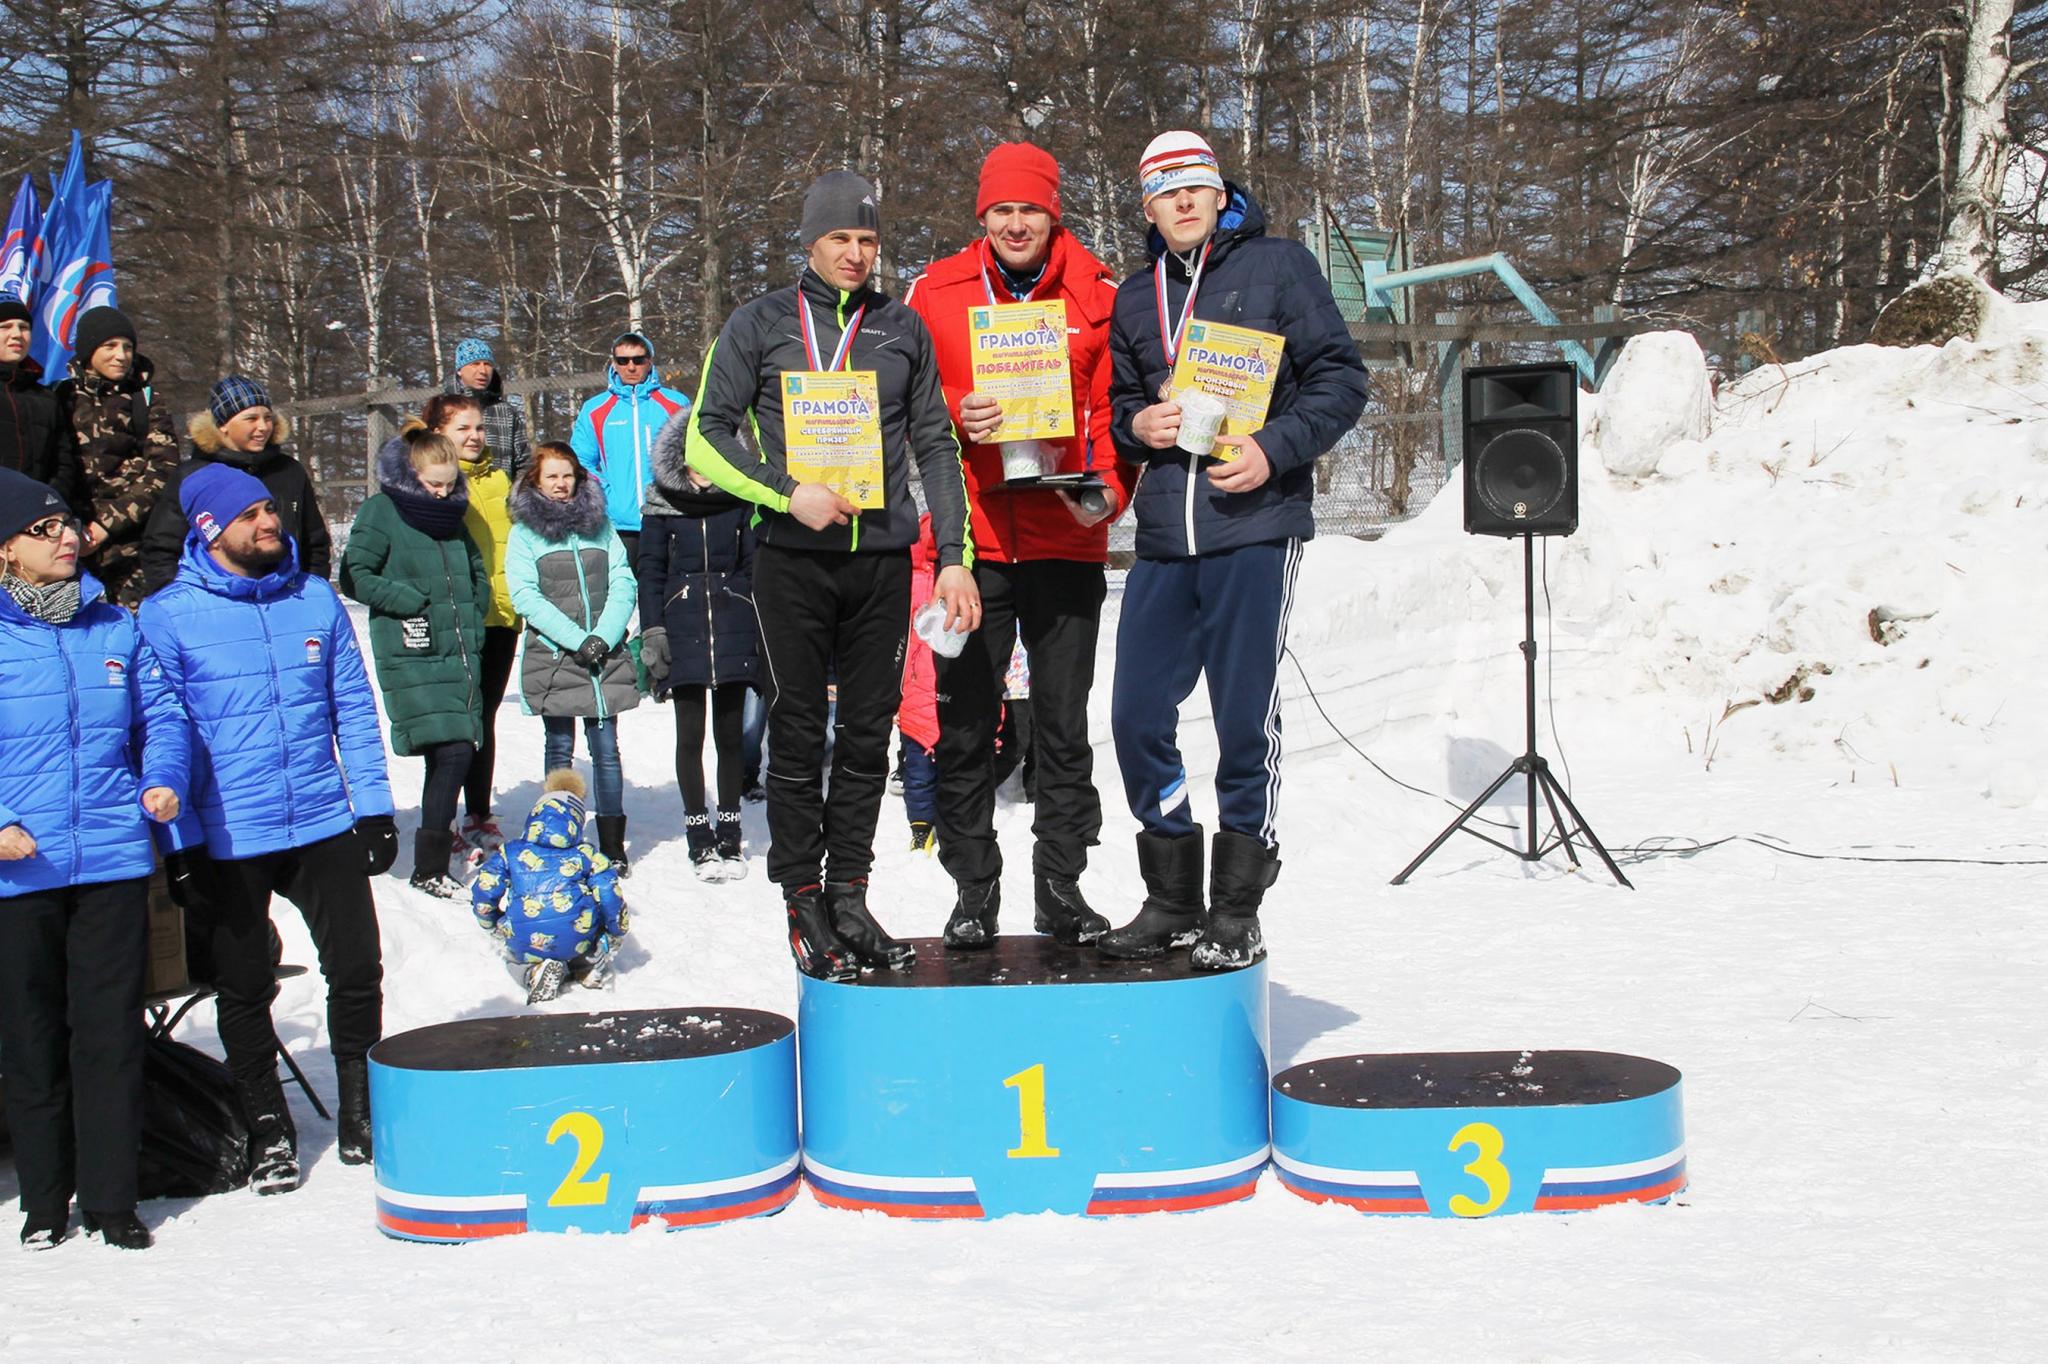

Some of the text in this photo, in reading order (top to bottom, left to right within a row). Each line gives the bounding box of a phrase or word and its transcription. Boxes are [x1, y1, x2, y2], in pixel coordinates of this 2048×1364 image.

[980, 330, 1058, 350] ГРАМОТА
[976, 358, 1062, 375] ПОБЕДИТЕЛЬ
[1187, 347, 1266, 375] ГРАМОТА
[1193, 375, 1248, 392] БРОНЗОВЫЙ
[1202, 385, 1237, 397] ПРИЗЕР
[792, 400, 870, 416] ГРАМОТА
[815, 435, 849, 445] ПРИЗЕР
[1002, 1063, 1061, 1159] 1
[545, 1111, 611, 1208] 2
[1448, 1122, 1511, 1218] 3
